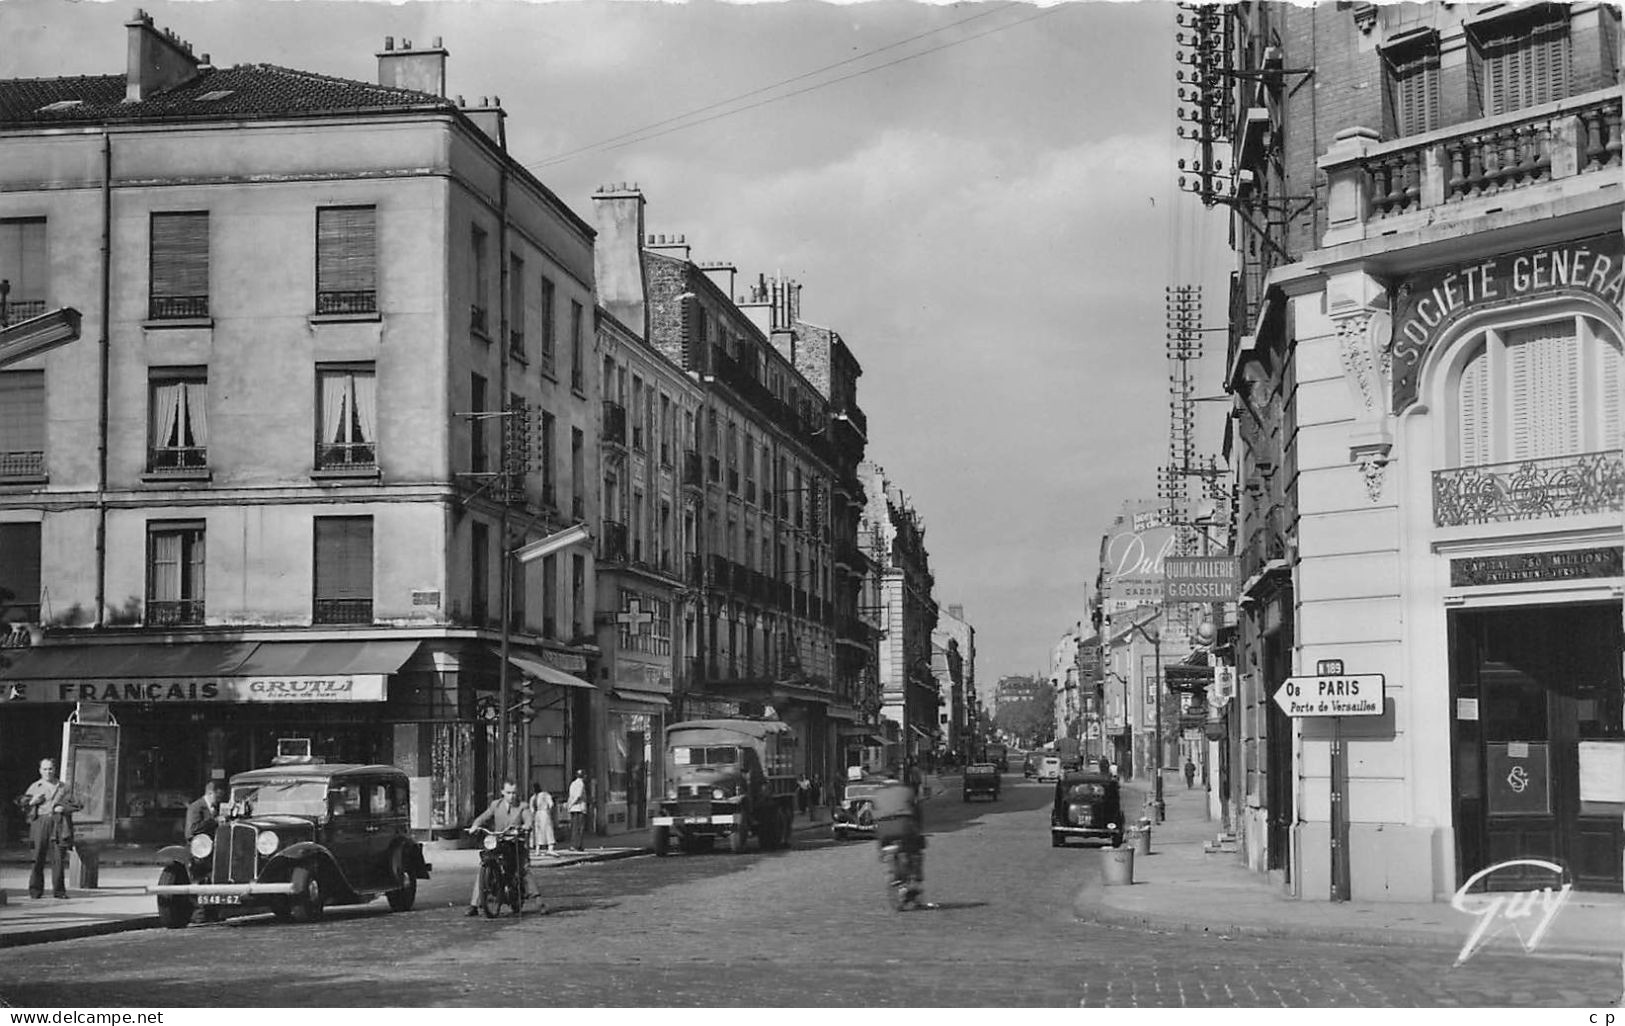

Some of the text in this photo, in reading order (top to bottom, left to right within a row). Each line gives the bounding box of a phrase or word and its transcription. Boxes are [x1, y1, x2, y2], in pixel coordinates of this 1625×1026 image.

[1393, 260, 1497, 366] SOCIÉTÉ
[1166, 561, 1235, 579] QUINCAILLERIE
[1463, 560, 1509, 572] CAPITAL
[1552, 552, 1611, 566] MILLIONS
[59, 682, 219, 703] FRANÇAIS
[249, 680, 353, 693] GRUTLI
[1319, 681, 1360, 696] PARIS
[1290, 700, 1376, 713] Porte de Versailles
